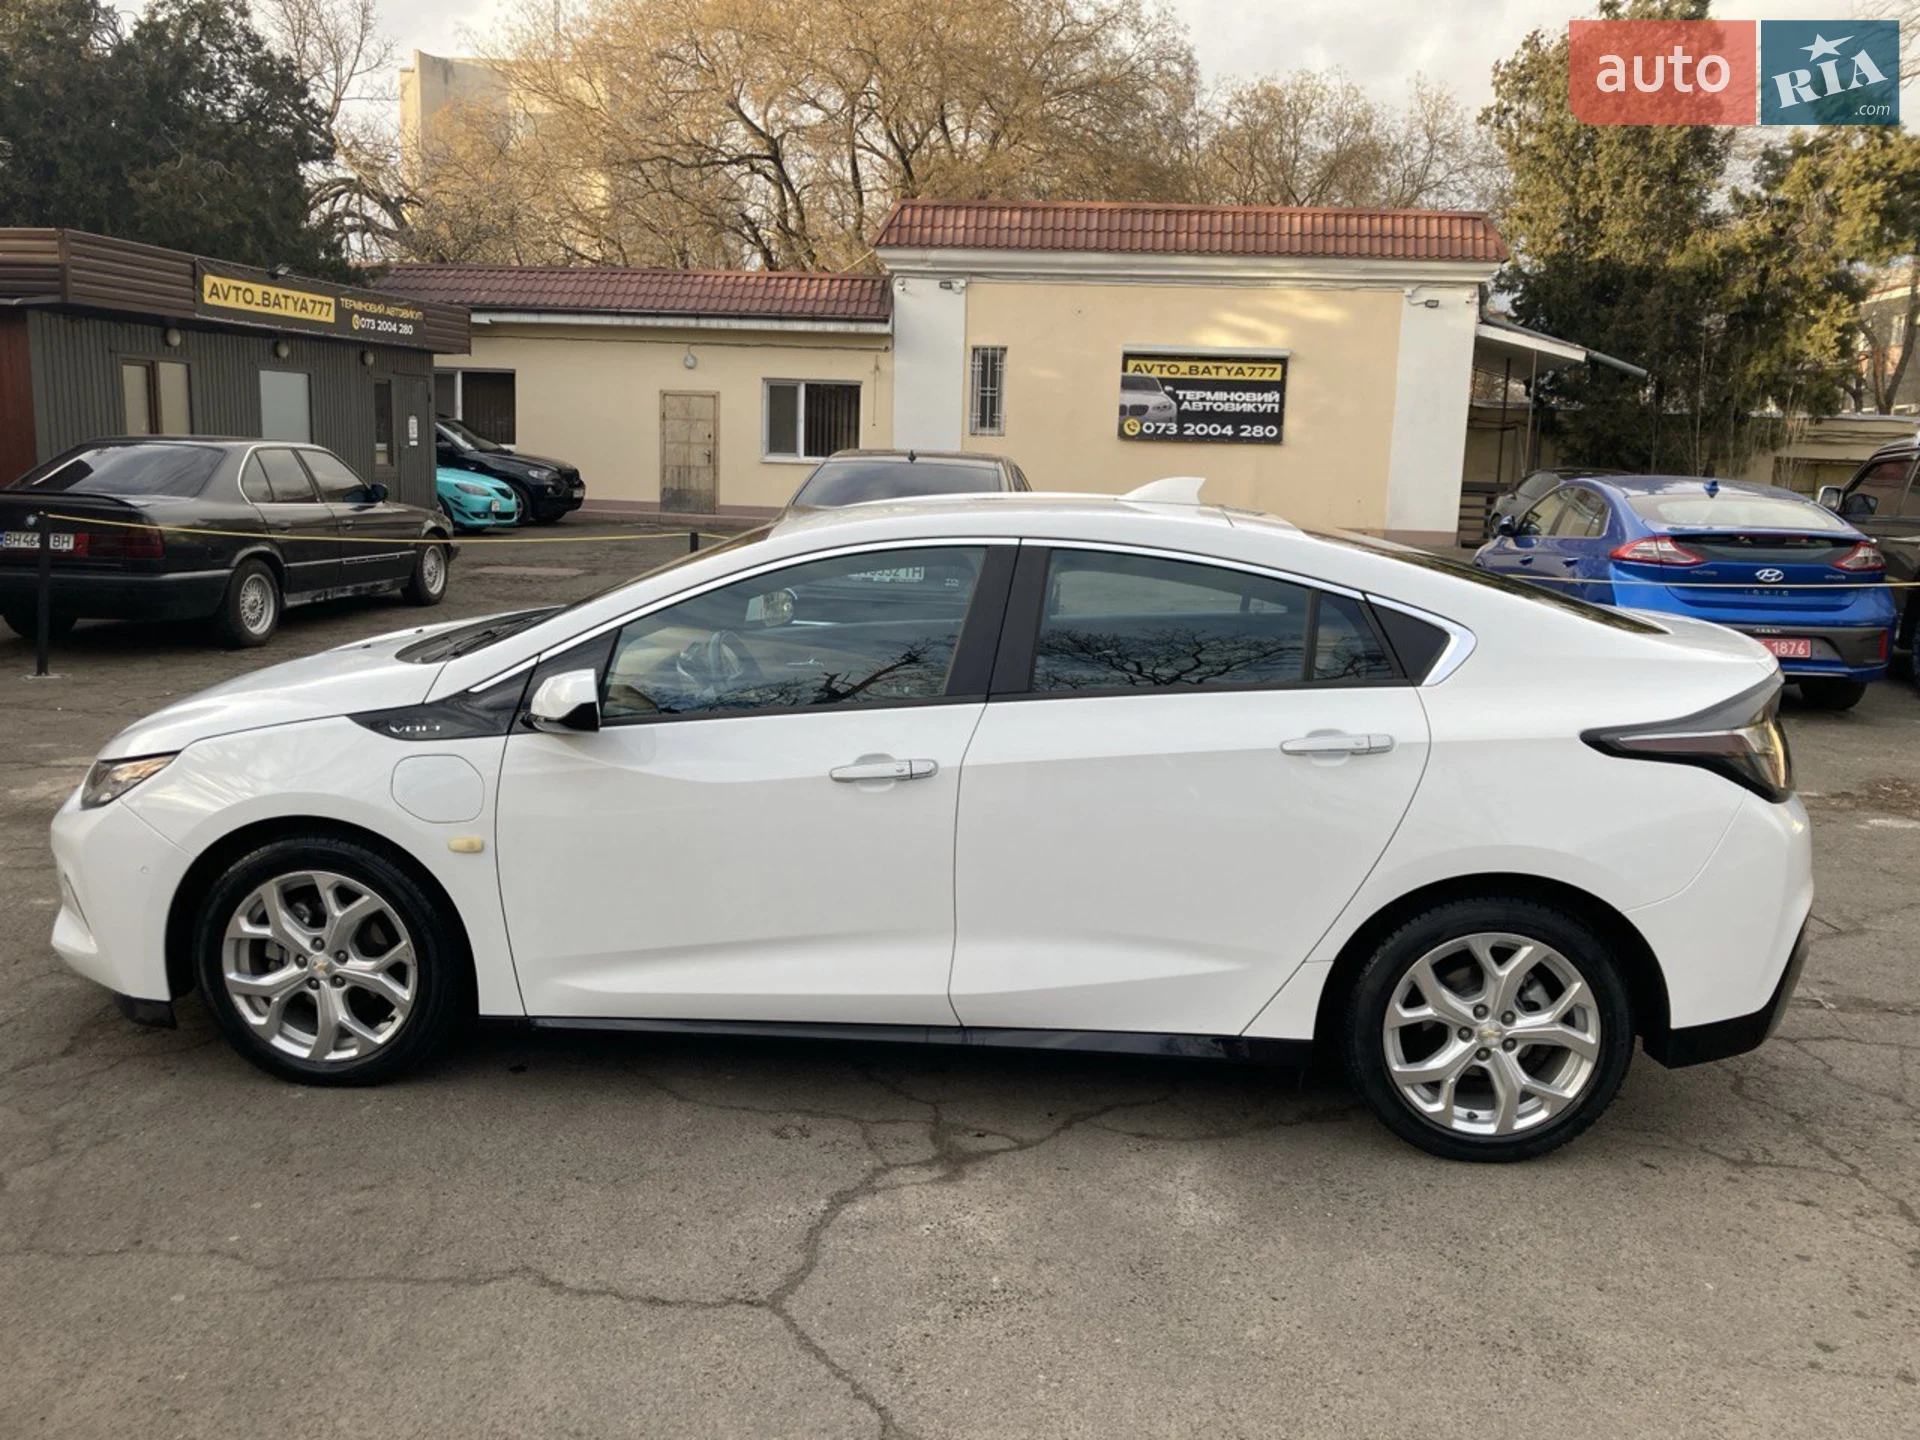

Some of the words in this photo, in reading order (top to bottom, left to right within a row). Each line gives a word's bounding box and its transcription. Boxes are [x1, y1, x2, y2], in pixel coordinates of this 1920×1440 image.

[208, 282, 332, 317] AVTO_BATYA777
[360, 317, 376, 330] 073
[377, 320, 398, 333] 2004
[398, 323, 414, 335] 280
[1131, 363, 1278, 377] AVTO_BATYA777
[1175, 390, 1280, 403] ТЕРМІНОВИЙ
[1180, 401, 1280, 413] АВТОВИКУП
[1142, 422, 1178, 435] 073
[1183, 423, 1234, 436] 2004
[1239, 425, 1278, 438] 280
[1772, 641, 1806, 655] 1876
